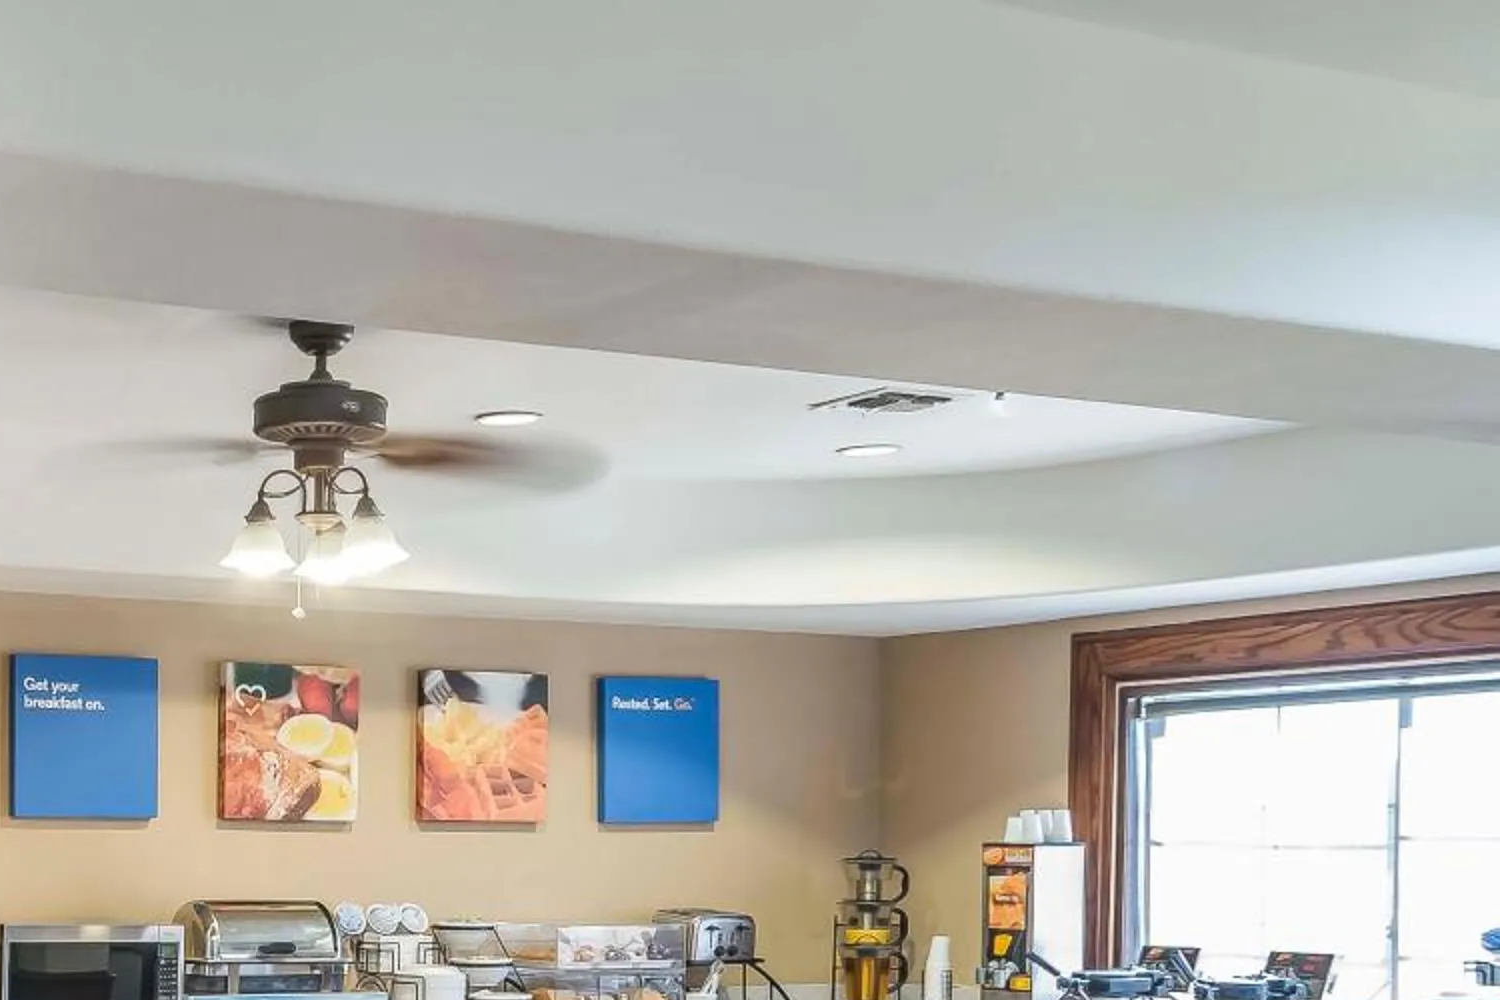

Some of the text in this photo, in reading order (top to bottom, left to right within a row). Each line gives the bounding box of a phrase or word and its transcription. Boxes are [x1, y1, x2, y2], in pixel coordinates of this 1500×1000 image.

[23, 676, 80, 694] Get your
[23, 694, 105, 711] breakfast on.
